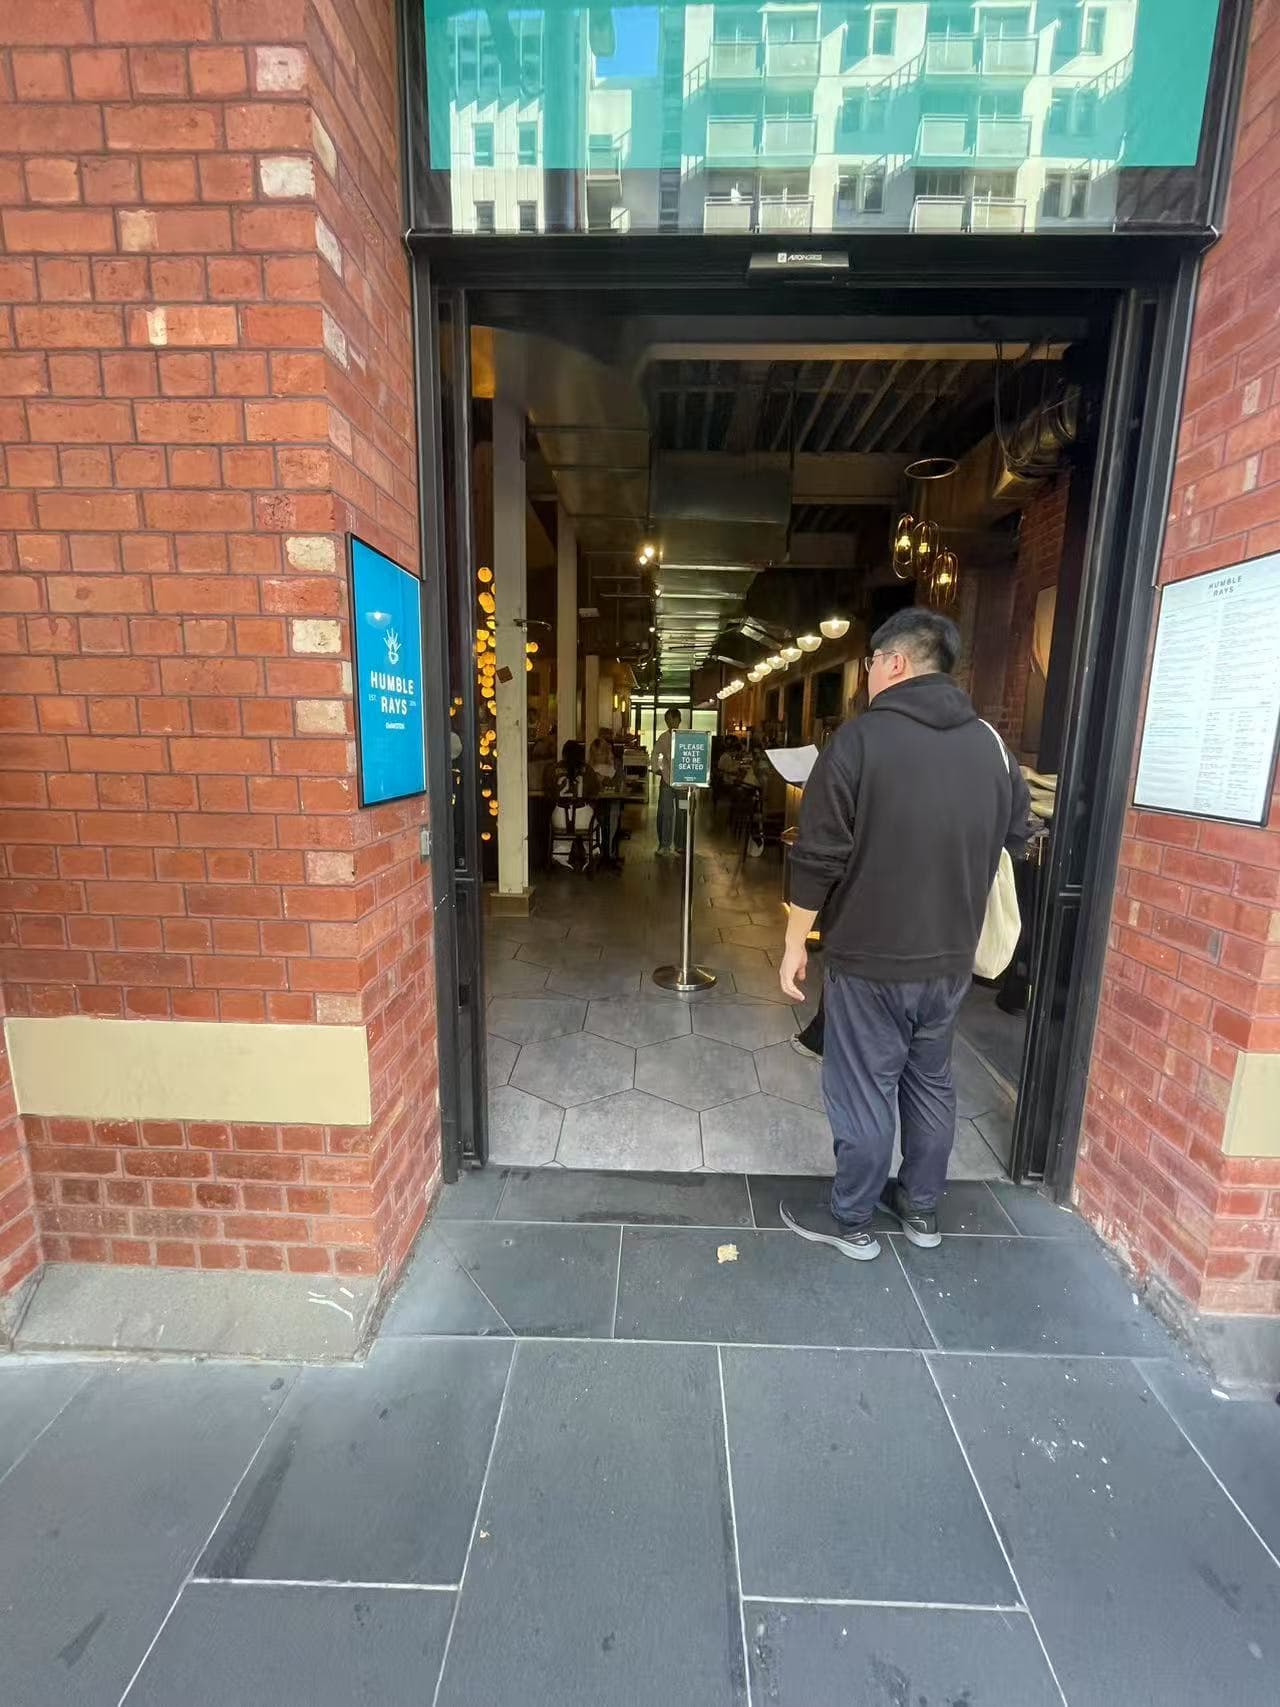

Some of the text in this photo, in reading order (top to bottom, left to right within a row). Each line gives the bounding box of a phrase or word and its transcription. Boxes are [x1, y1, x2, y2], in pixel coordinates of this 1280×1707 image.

[1208, 576, 1242, 589] HUMBLE
[1213, 586, 1234, 596] RAYS
[371, 670, 414, 695] HUMBLE
[381, 696, 407, 716] RAYS
[558, 775, 583, 797] 21
